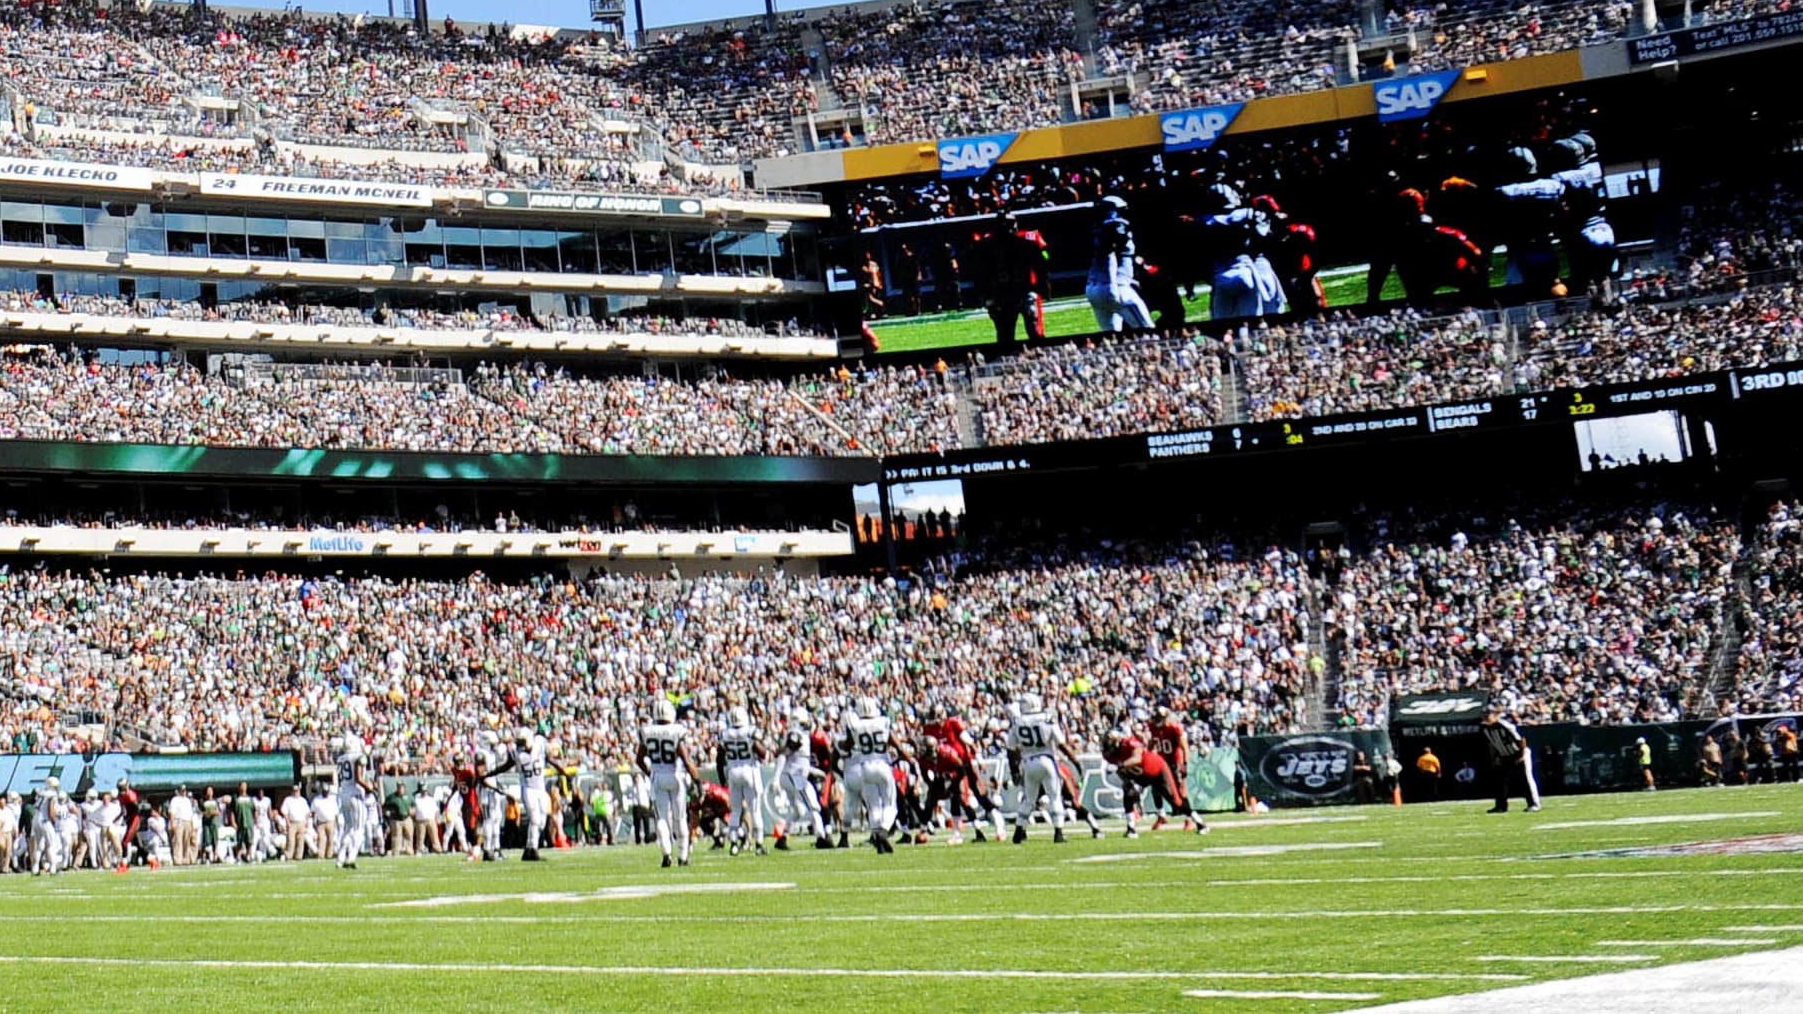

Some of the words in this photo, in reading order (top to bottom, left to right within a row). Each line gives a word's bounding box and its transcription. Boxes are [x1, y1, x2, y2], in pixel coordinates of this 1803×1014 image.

[1636, 35, 1671, 50] Need
[1709, 37, 1729, 48] call
[1638, 45, 1677, 61] Help?
[1376, 81, 1443, 114] SAP
[1162, 109, 1228, 146] SAP
[939, 141, 1001, 172] SAP
[0, 164, 40, 175] JOE
[43, 167, 118, 182] KLECKO
[212, 178, 236, 189] 24
[262, 181, 351, 196] FREEMAN
[530, 194, 573, 209] RING
[575, 196, 599, 209] OF
[599, 197, 660, 212] HONOR
[1741, 372, 1785, 391] 3RD
[1630, 389, 1652, 401] AND
[1433, 402, 1492, 418] BENGALS
[1519, 397, 1535, 409] 21
[1435, 415, 1478, 430] BEARS
[1523, 409, 1538, 420] 17
[1147, 430, 1213, 447] SEAHAWKS
[1149, 442, 1210, 458] PANTHERS
[309, 537, 364, 551] MetLife
[559, 537, 601, 552] verizon
[858, 732, 888, 756] 95
[1017, 725, 1045, 748] 91
[646, 738, 676, 765] 26
[725, 740, 752, 761] 52
[1277, 757, 1348, 776] JETS
